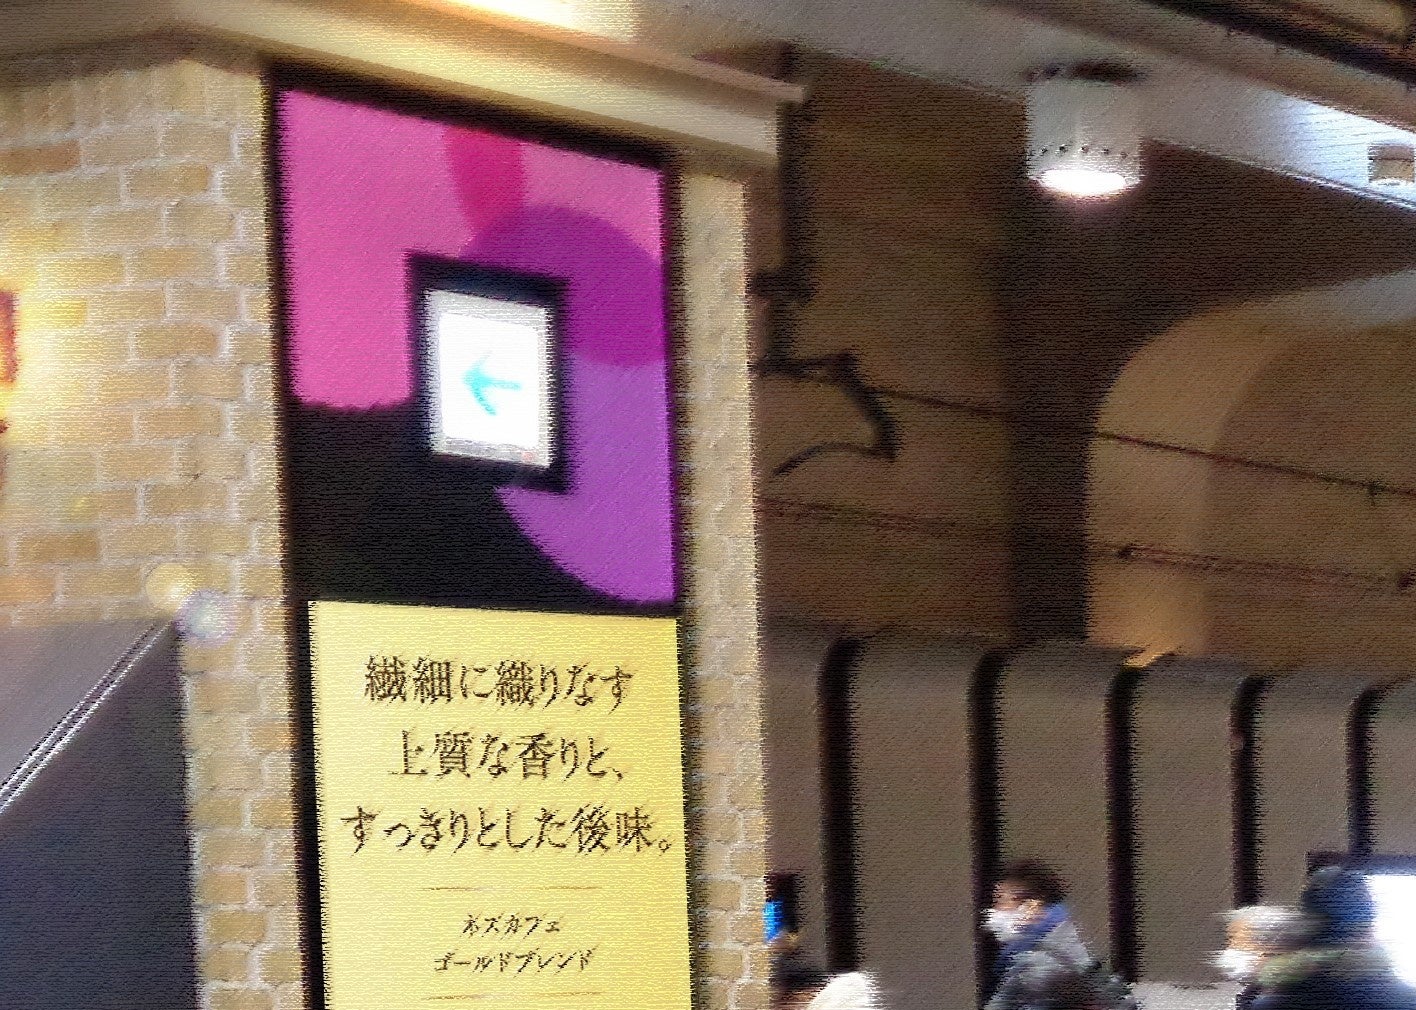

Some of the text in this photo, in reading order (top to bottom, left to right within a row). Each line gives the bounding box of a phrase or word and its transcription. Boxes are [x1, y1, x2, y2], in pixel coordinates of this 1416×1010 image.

[365, 655, 633, 713] 繊細に織りなす
[389, 730, 624, 780] 上質な香りと、
[341, 805, 673, 856] すっきりとした後味。
[463, 914, 561, 938] ネスカフェ
[433, 948, 597, 976] ゴールドブレンド
